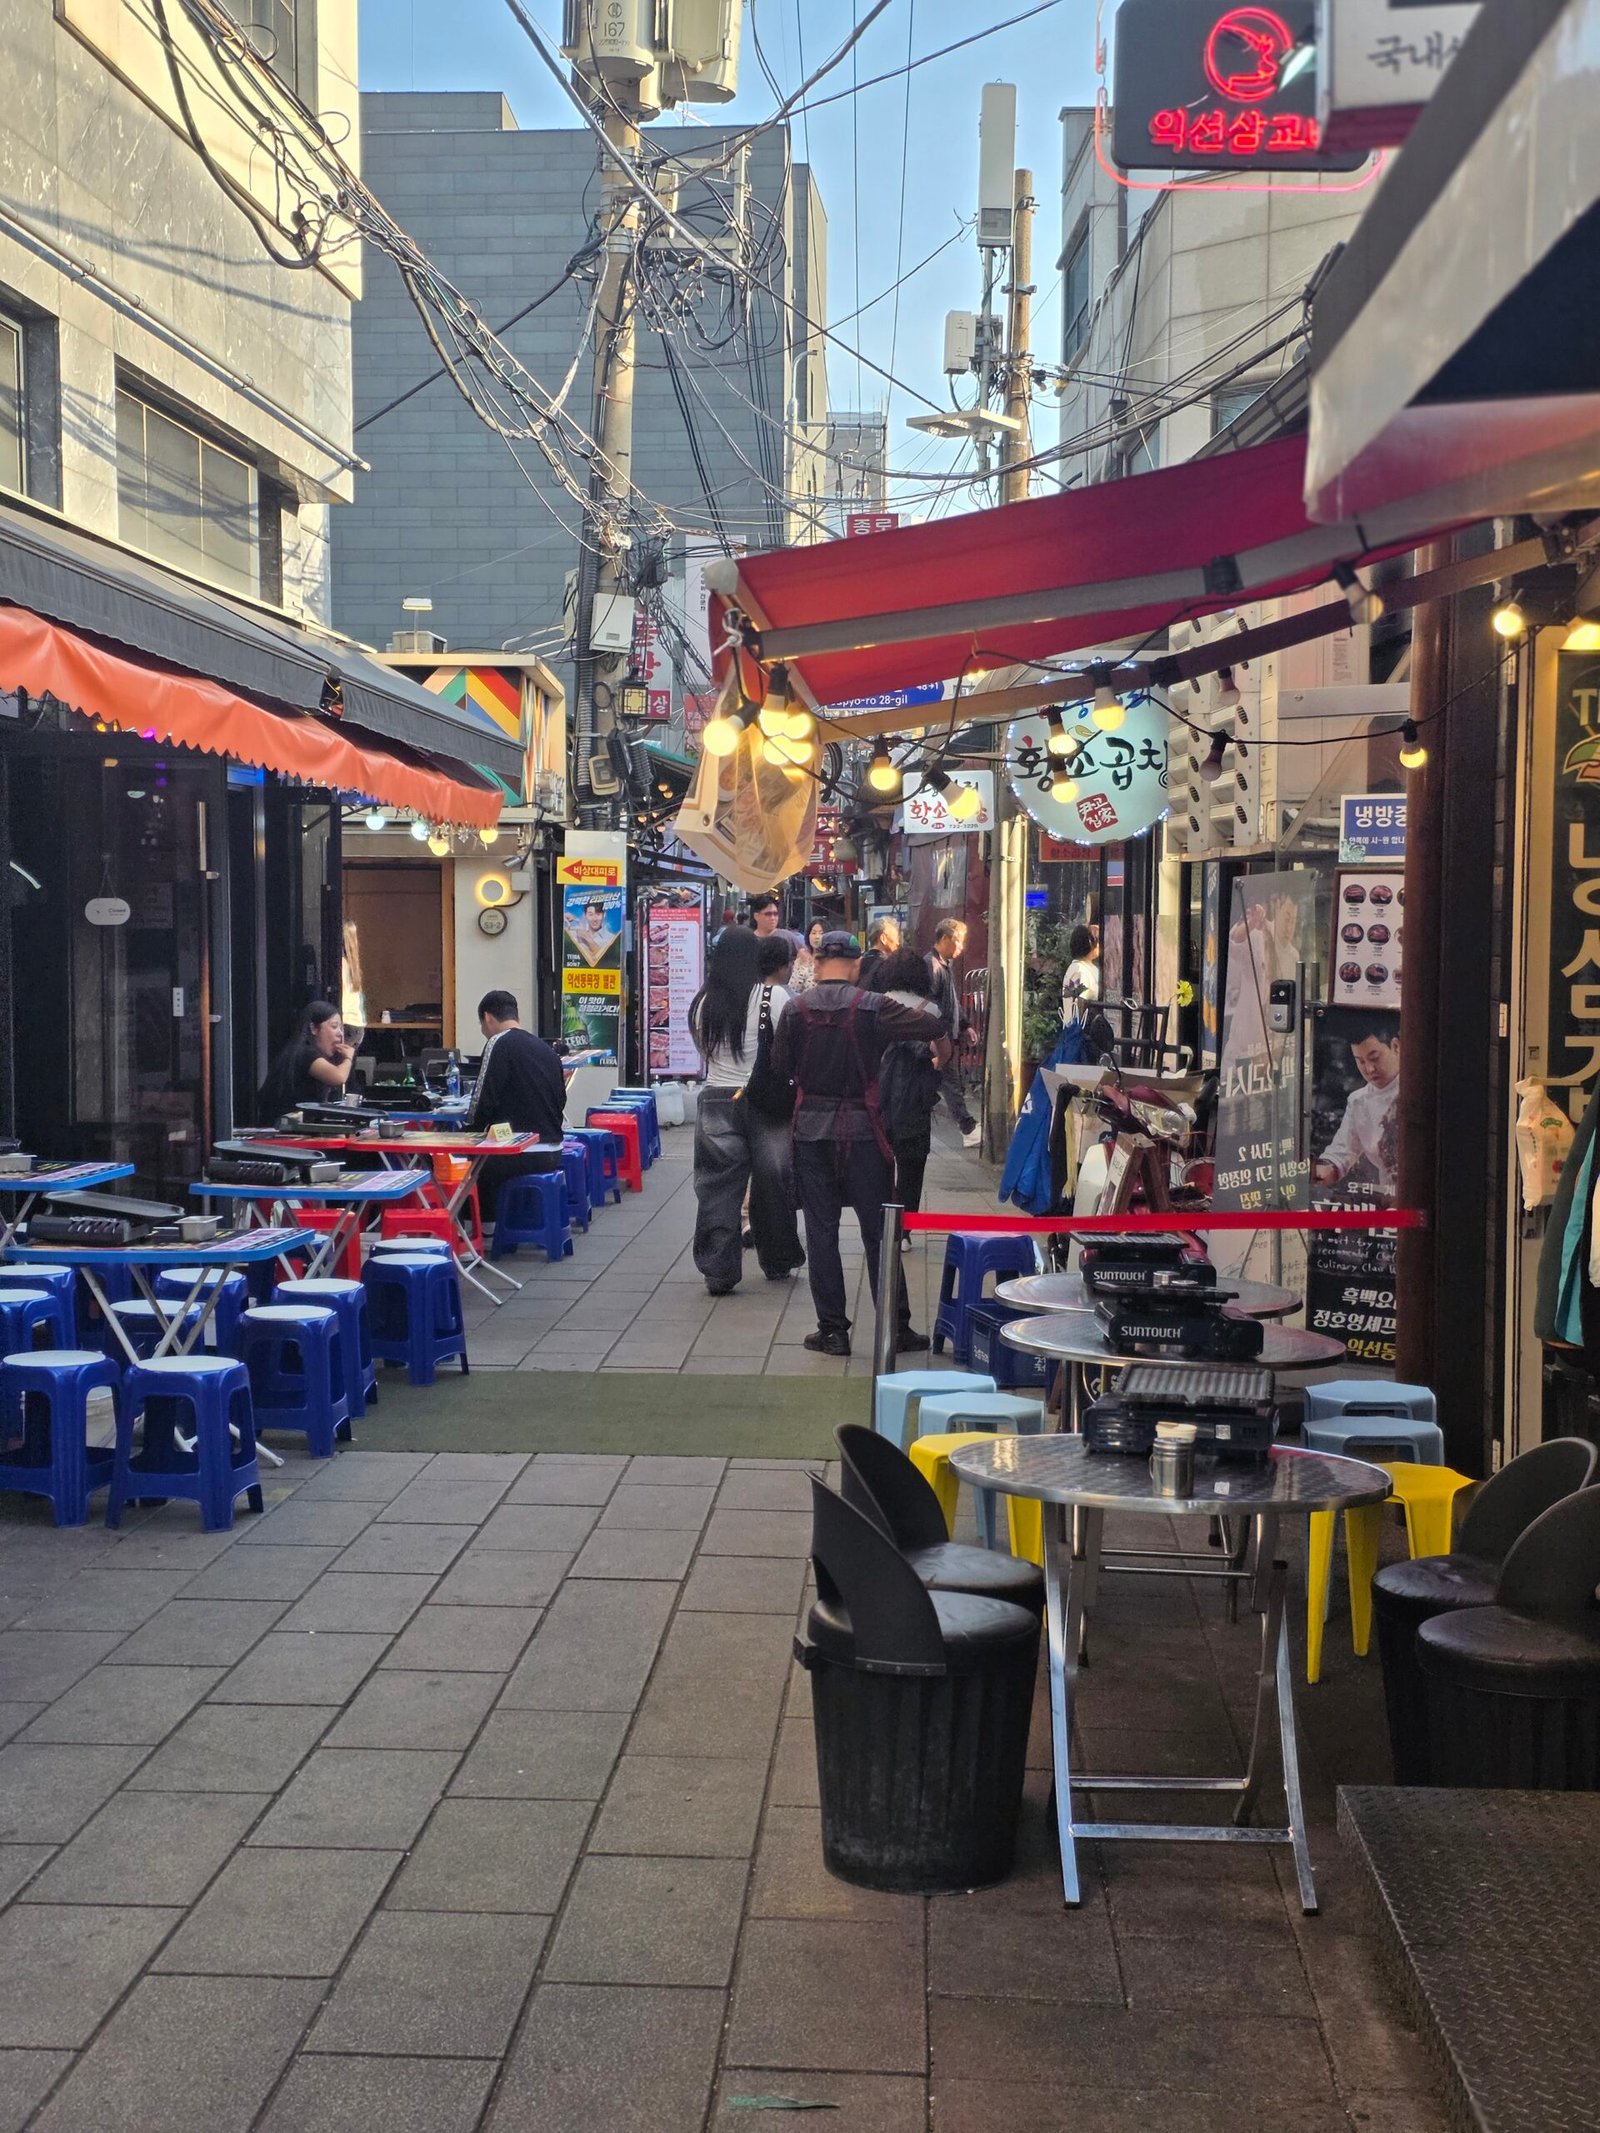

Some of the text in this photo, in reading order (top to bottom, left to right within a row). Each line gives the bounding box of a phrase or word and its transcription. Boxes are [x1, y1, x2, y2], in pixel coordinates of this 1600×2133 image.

[604, 21, 625, 37] 167
[879, 695, 908, 707] 28-gil
[1354, 805, 1406, 828] 냉방중
[1347, 1181, 1373, 1195] 요리
[1316, 1260, 1358, 1272] Culinary
[1362, 1263, 1385, 1273] Class
[1093, 1270, 1146, 1281] SUNTOUCH
[1121, 1325, 1182, 1339] SUNTOUCH
